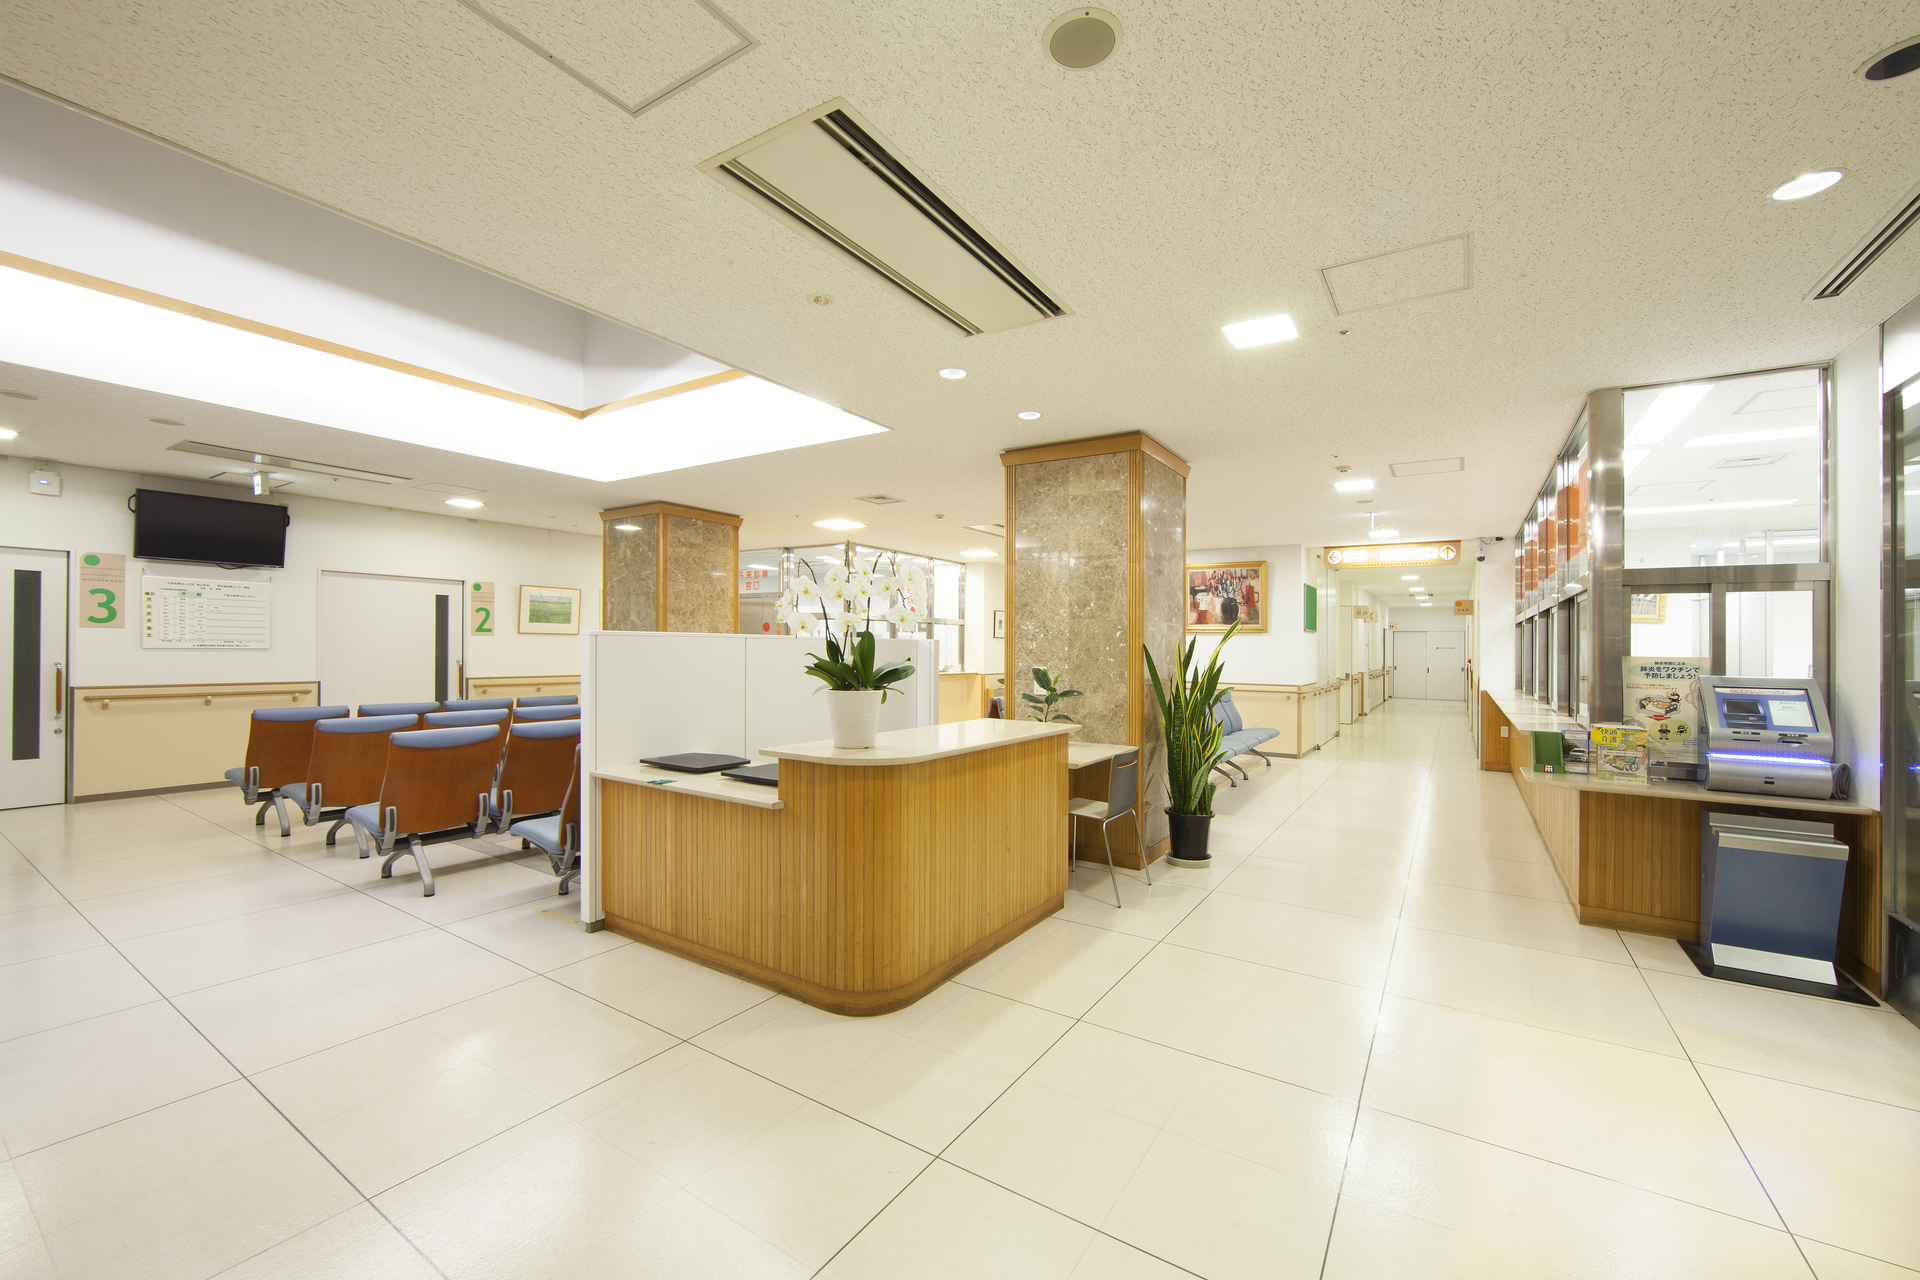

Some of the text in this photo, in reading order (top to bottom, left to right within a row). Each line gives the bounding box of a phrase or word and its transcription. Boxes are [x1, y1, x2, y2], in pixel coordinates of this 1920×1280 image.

[87, 588, 118, 624] 3
[474, 607, 493, 633] 2
[1639, 666, 1700, 674] 肺炎をワクチンで
[1601, 728, 1618, 736] 快適
[1601, 735, 1618, 743] 介護
